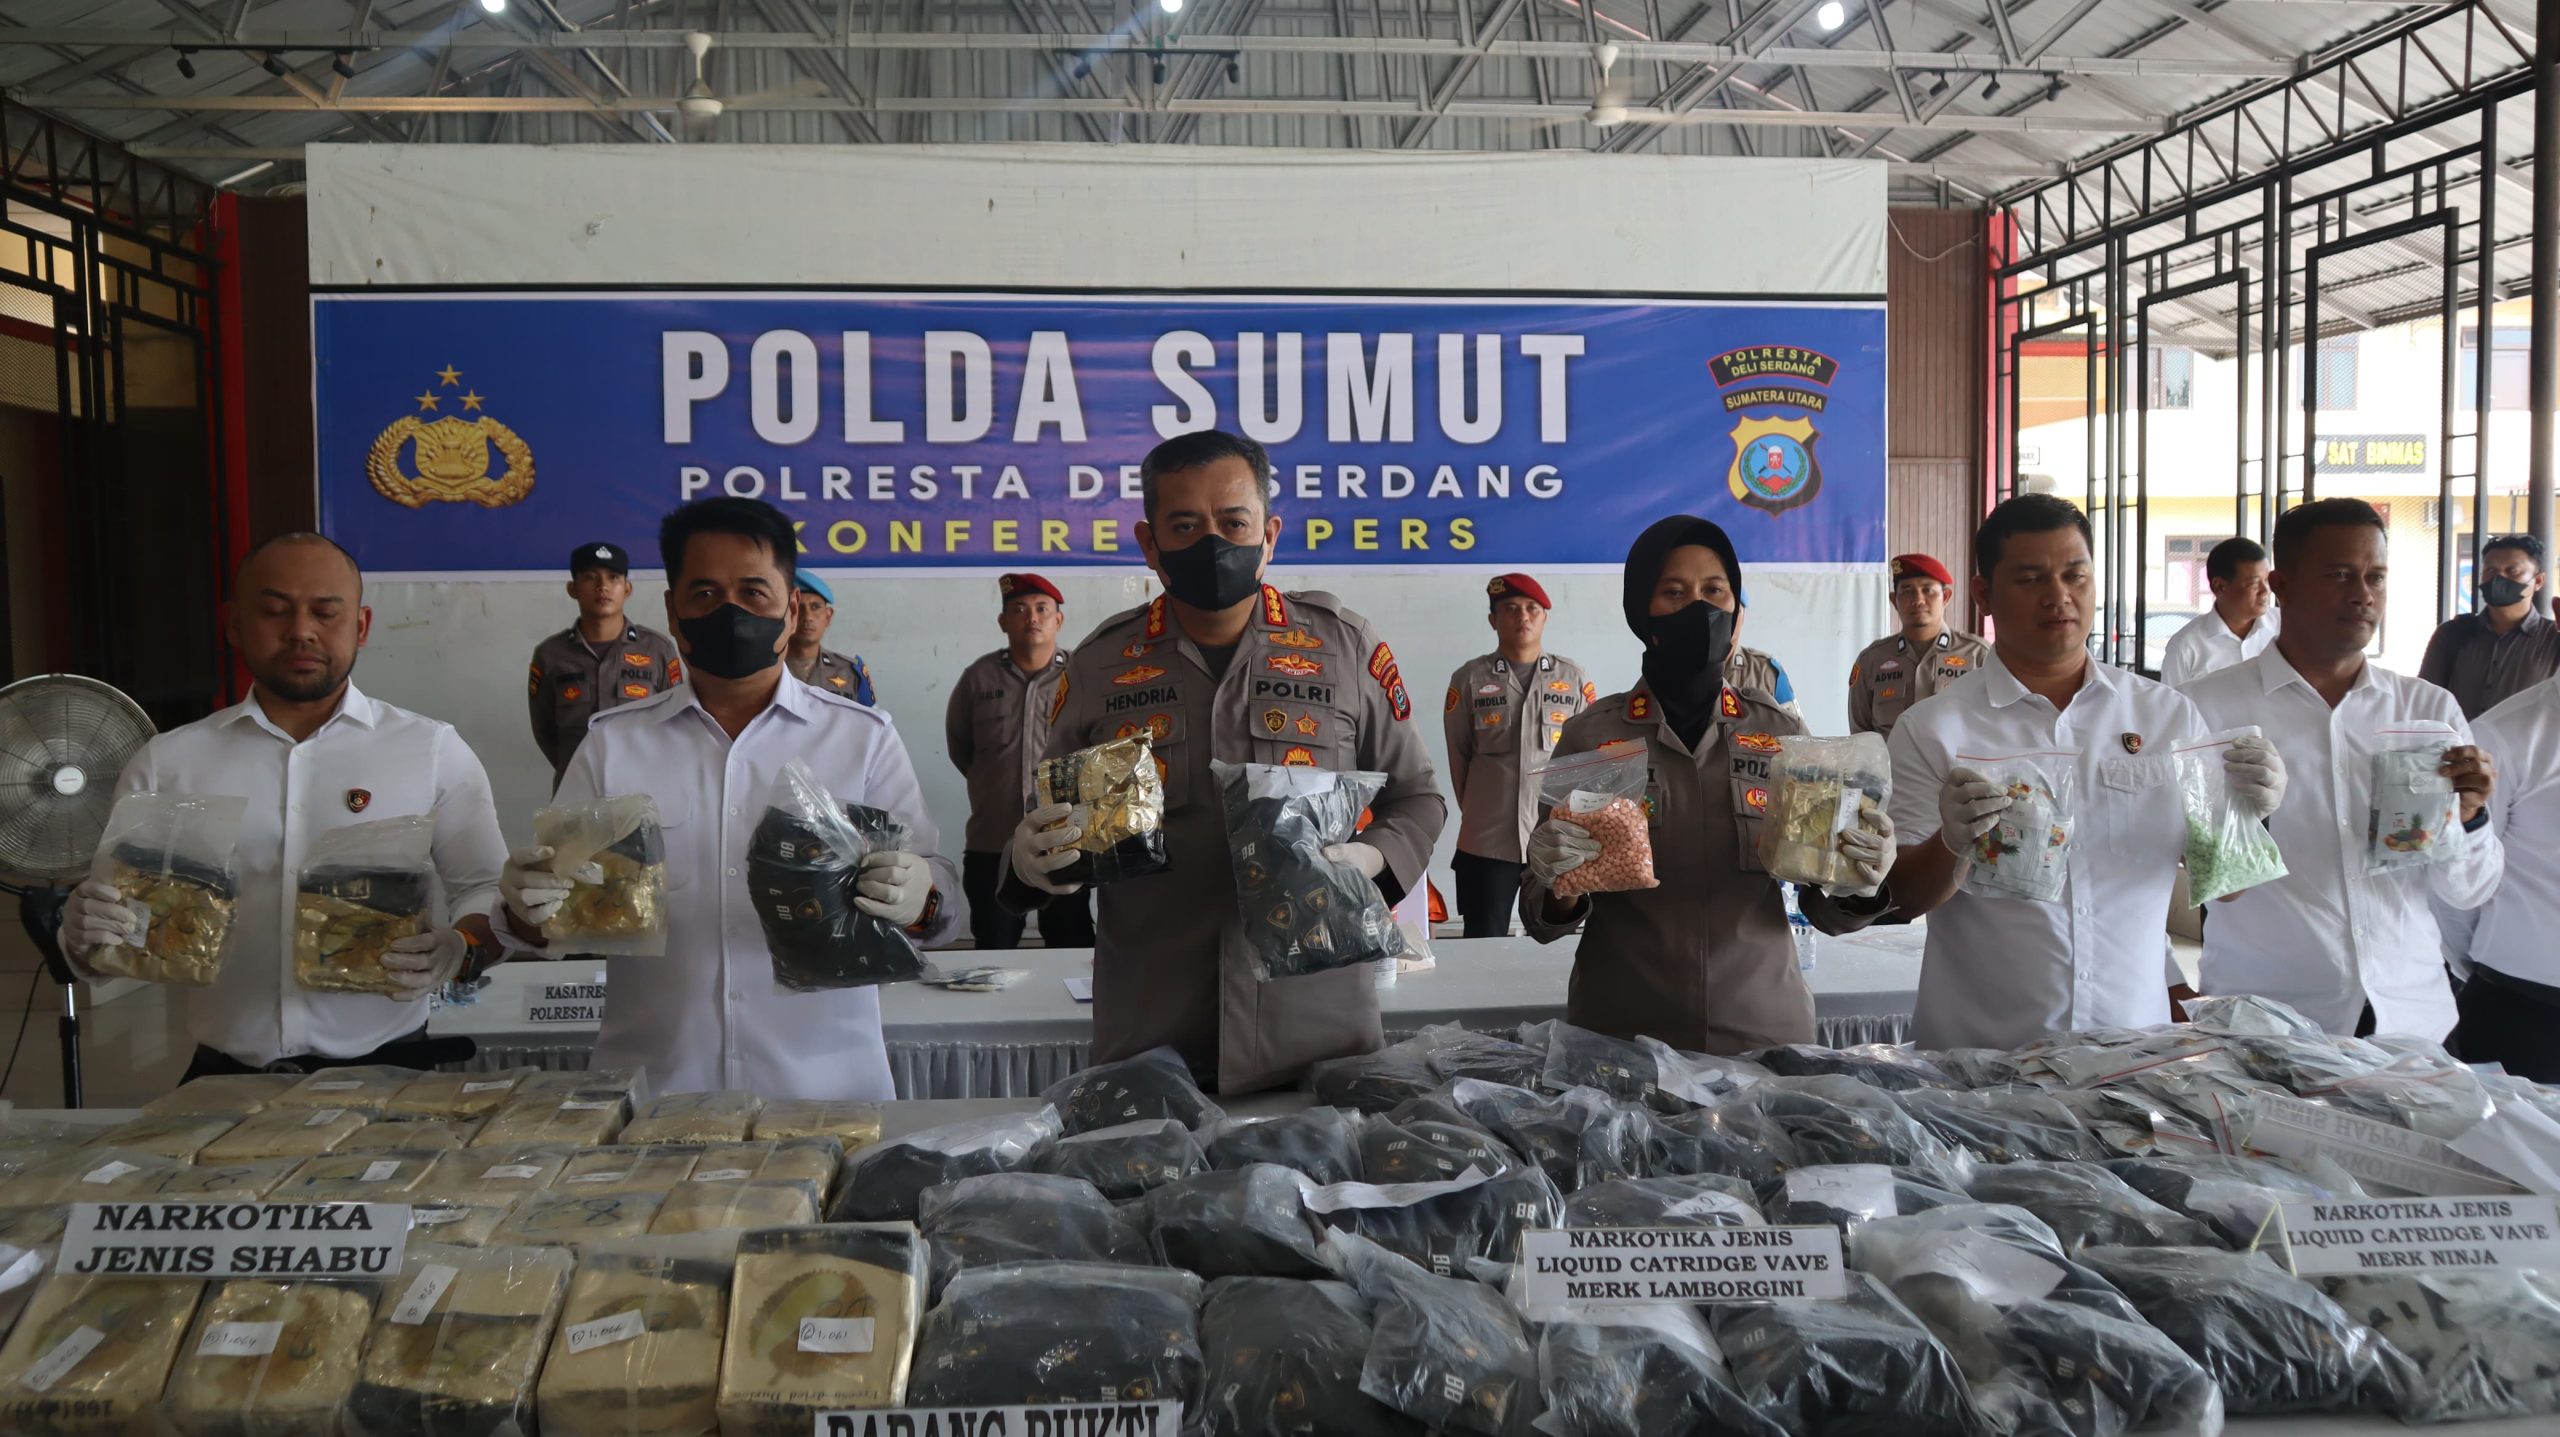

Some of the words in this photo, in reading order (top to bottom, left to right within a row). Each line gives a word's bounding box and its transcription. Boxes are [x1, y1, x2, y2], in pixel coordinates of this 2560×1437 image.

[1723, 348, 1822, 367] POLRESTA
[1731, 363, 1757, 377] DELI
[1760, 361, 1815, 376] SERDANG
[663, 329, 1087, 445] POLDA
[1151, 329, 1586, 445] SUMUT
[1726, 390, 1785, 409] SUMATERA
[1788, 392, 1823, 410] UTARA
[2327, 441, 2359, 465] SAT
[681, 465, 1029, 500] POLRESTA
[1069, 465, 1143, 499] DE
[1268, 464, 1563, 499] SERDANG
[1305, 517, 1476, 552] PERS
[1938, 668, 1967, 678] POL
[1105, 686, 1177, 713] HENDRIA
[1255, 680, 1331, 703] POLRI
[1543, 693, 1575, 706] POLRI
[1733, 758, 1770, 779] POL
[529, 1006, 594, 1021] POLRESTA
[93, 1204, 373, 1232] NARKOTIKA
[2313, 1203, 2443, 1222] NARKOTIKA
[2449, 1201, 2513, 1219] JENIS
[1568, 1230, 1716, 1249] NARKOTIKA
[1721, 1230, 1794, 1248] JENIS
[2287, 1229, 2365, 1249] LIQUID
[2371, 1226, 2486, 1245] CATRIDGE
[2489, 1225, 2550, 1241] VAVE
[75, 1246, 215, 1274] JENIS
[230, 1246, 392, 1274] SHABU
[1536, 1256, 1622, 1276] LIQUID
[1629, 1255, 1758, 1275] CATRIDGE
[1763, 1254, 1829, 1272] VAVE
[2357, 1250, 2426, 1269] MERK
[2430, 1249, 2498, 1267] NINJA
[1566, 1281, 1642, 1299] MERK
[1648, 1279, 1805, 1300] LAMBORGINI
